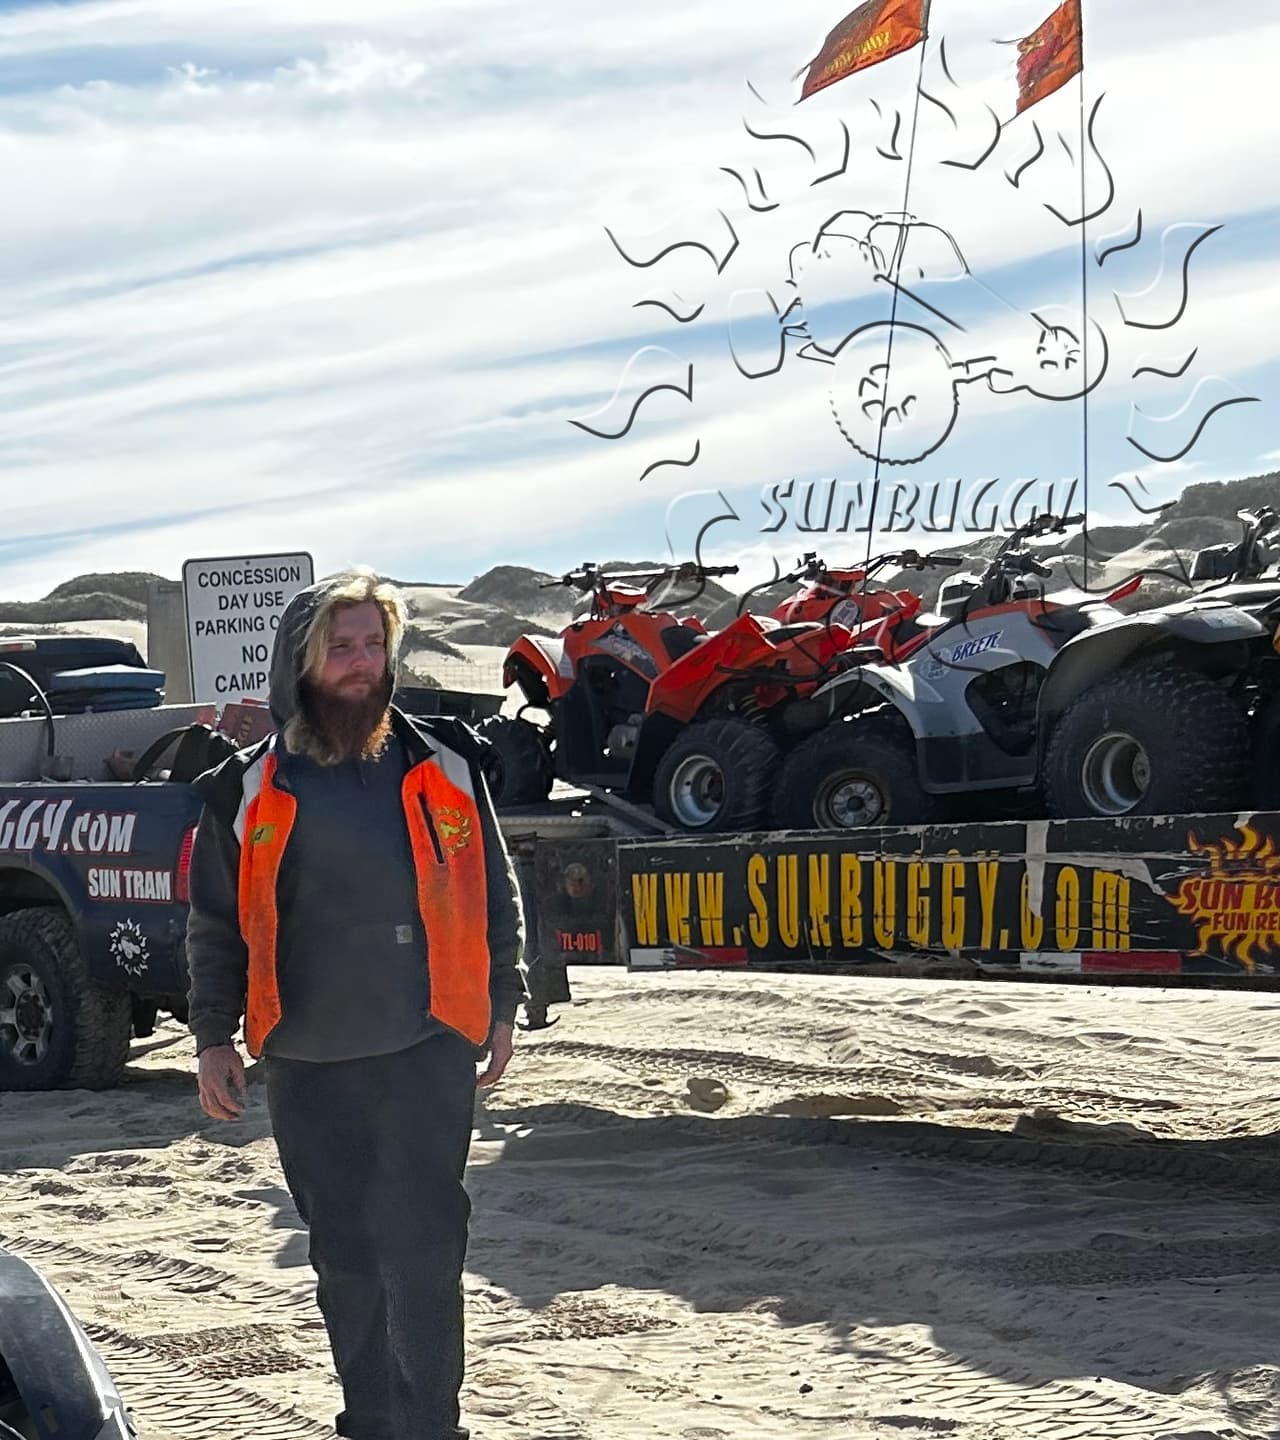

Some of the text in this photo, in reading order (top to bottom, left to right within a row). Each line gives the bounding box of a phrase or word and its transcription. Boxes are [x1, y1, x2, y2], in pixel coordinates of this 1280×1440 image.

[198, 566, 301, 588] CONCESSION
[218, 591, 285, 611] DAY USE
[195, 616, 265, 636] PARKING
[242, 644, 268, 664] NO
[215, 672, 267, 693] CAMP
[89, 868, 172, 900] SUN TRAM
[1181, 880, 1245, 911] SUN
[1213, 912, 1251, 931] FUN
